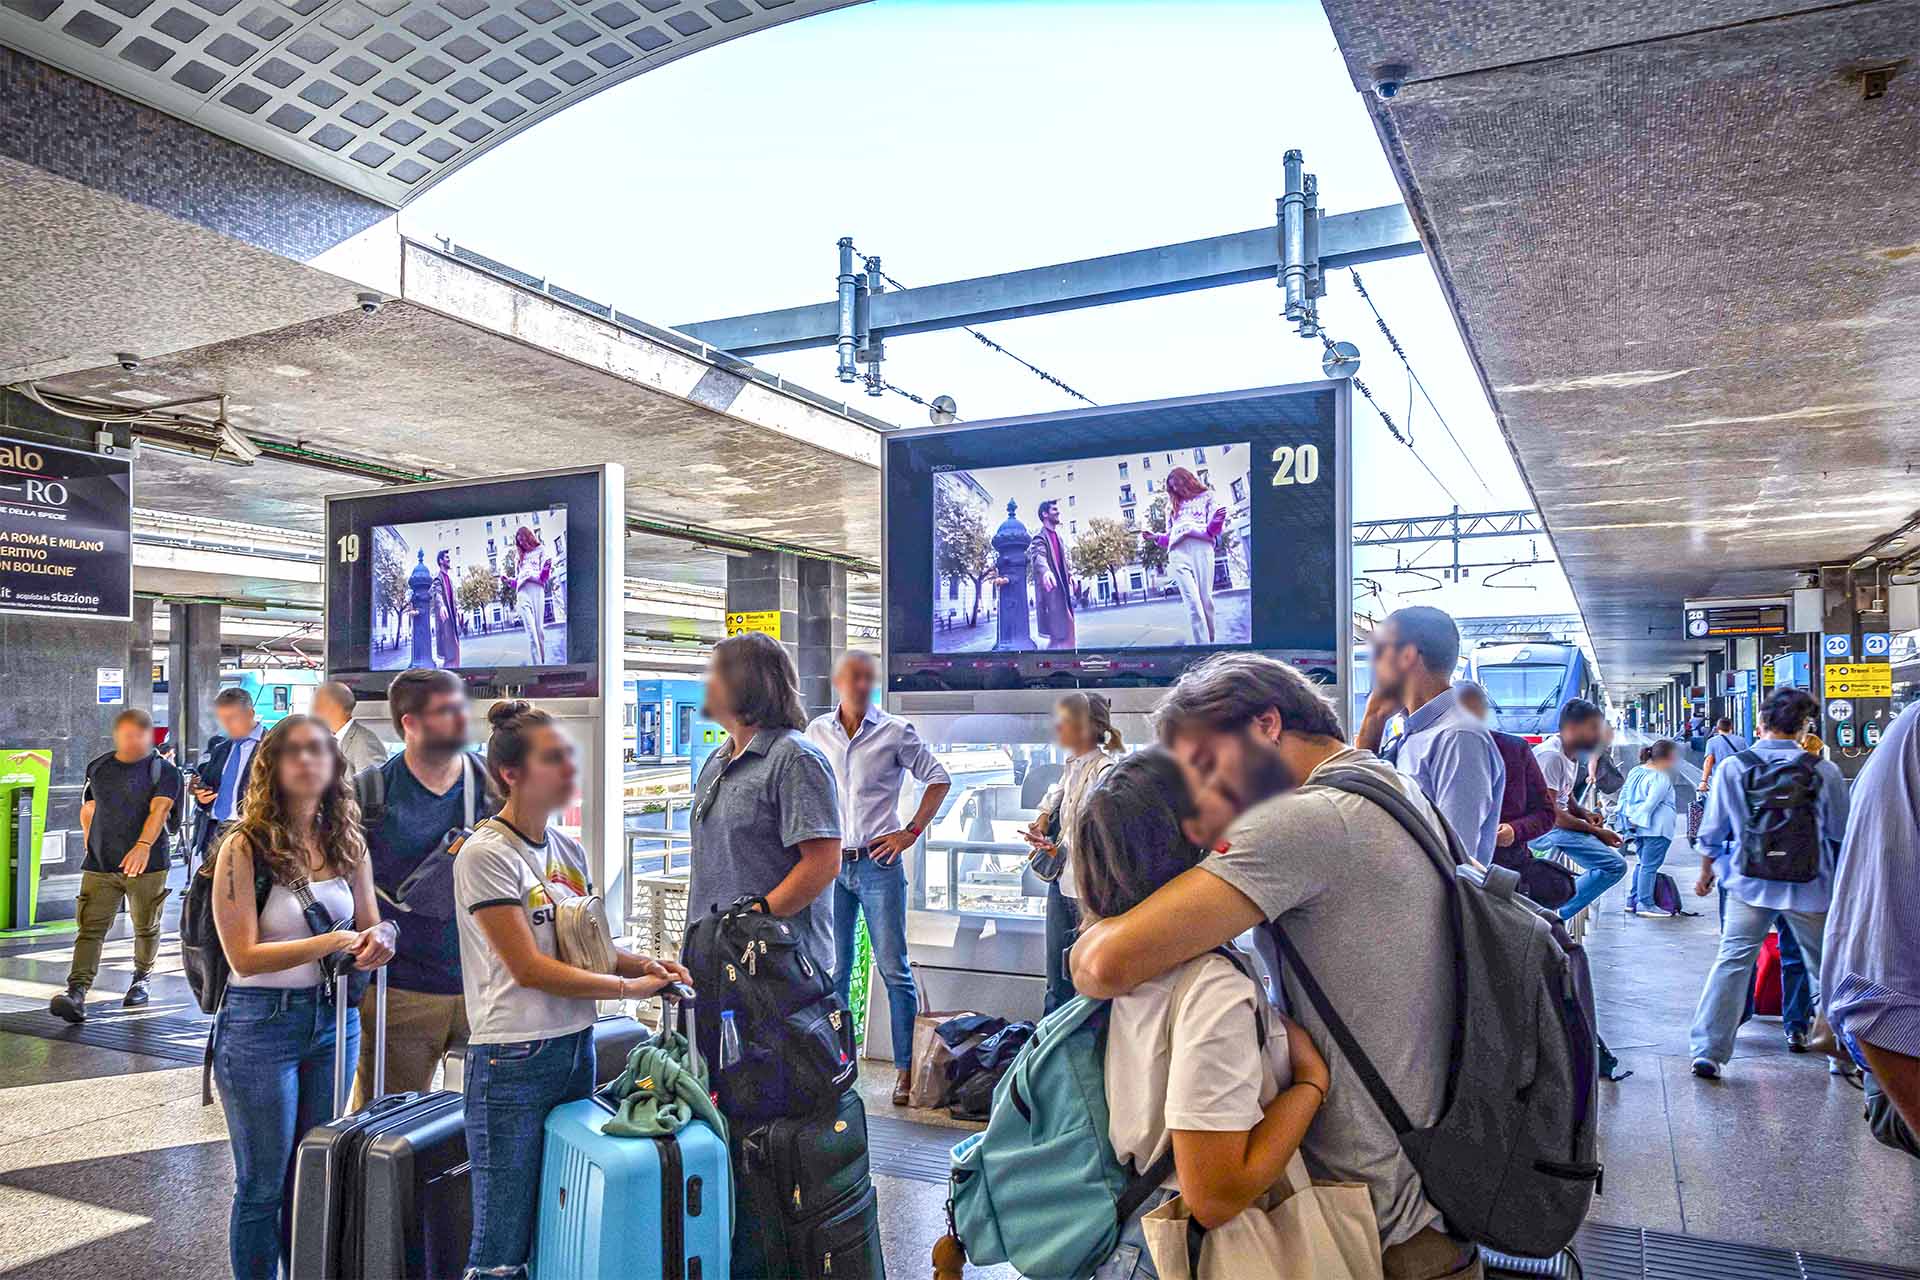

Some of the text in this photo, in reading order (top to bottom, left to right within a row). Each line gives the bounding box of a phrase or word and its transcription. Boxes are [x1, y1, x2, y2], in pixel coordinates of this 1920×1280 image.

[1271, 444, 1319, 486] 20
[26, 480, 68, 505] RO
[8, 507, 37, 517] DELLA
[11, 533, 48, 546] ROMA
[49, 536, 57, 547] E
[58, 537, 104, 552] MILANO
[336, 534, 360, 563] 19
[50, 591, 100, 605] stazione
[1688, 611, 1704, 620] 20
[1828, 640, 1846, 650] 20
[1868, 639, 1883, 649] 21
